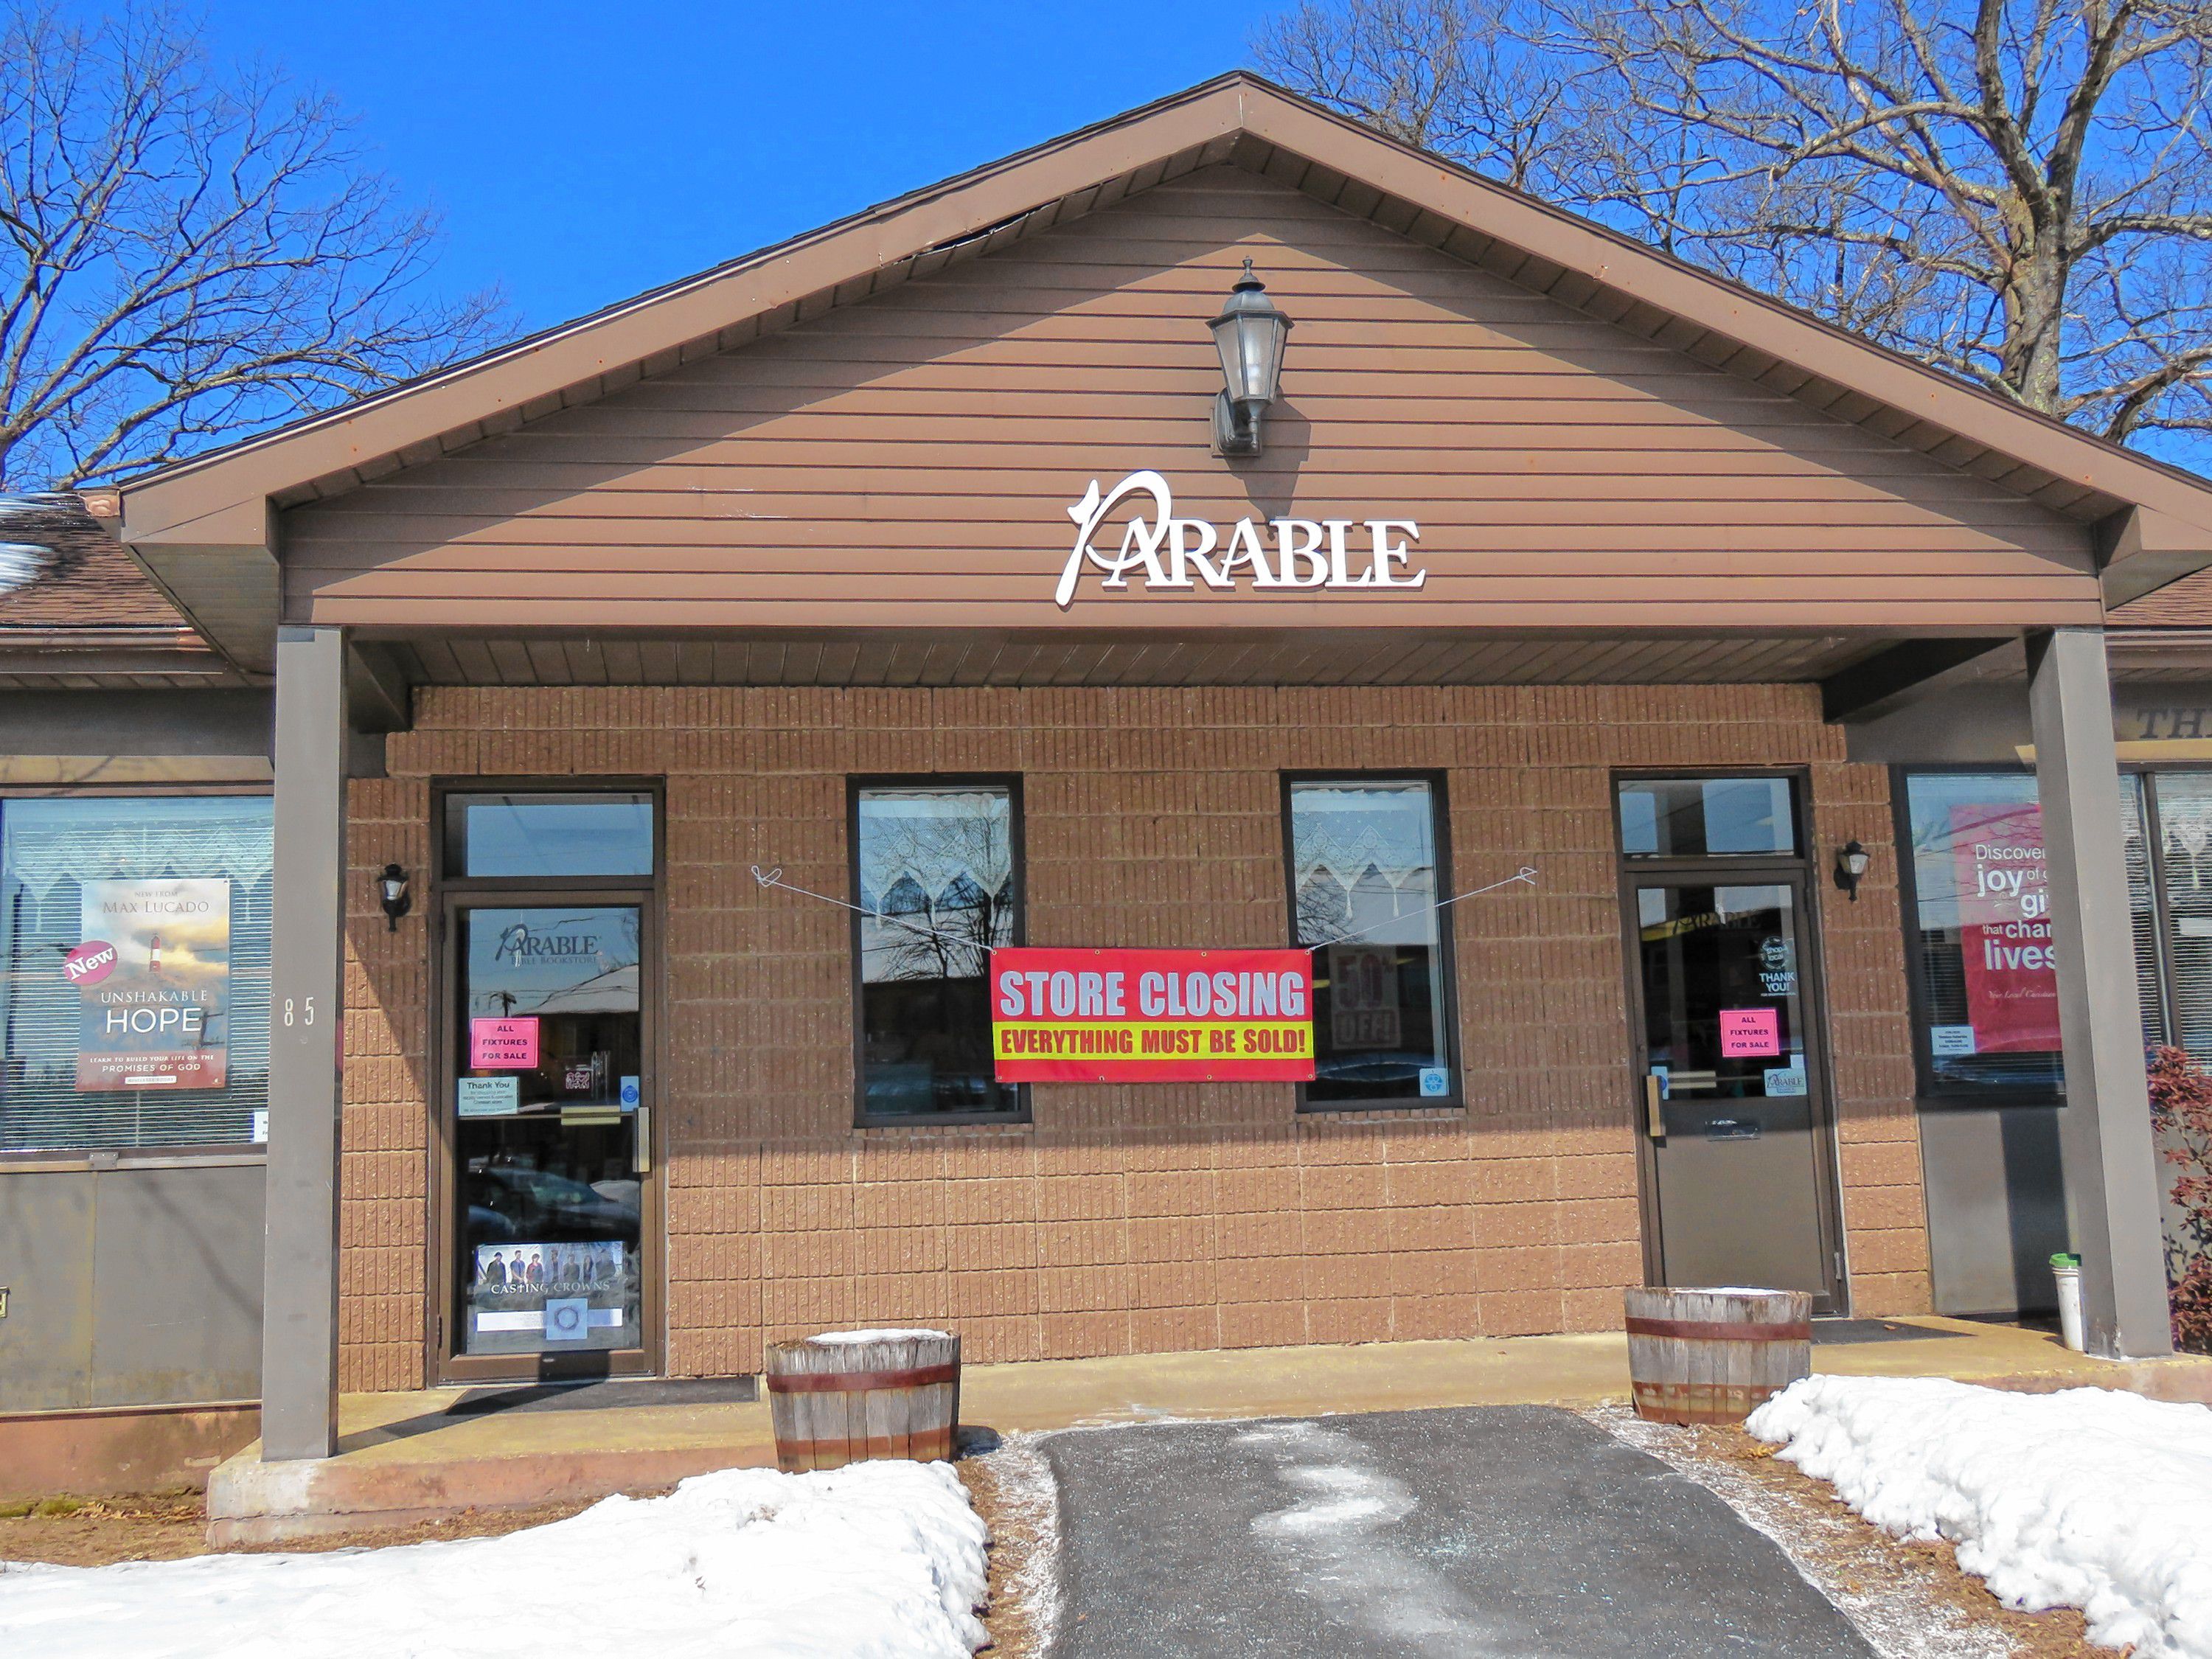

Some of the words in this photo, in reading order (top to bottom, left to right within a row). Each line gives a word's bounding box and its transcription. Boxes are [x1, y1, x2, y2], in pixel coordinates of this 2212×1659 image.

[1054, 469, 1427, 607] PARABLE
[2136, 706, 2212, 739] TH
[1977, 863, 2024, 897] joy
[2027, 867, 2040, 880] of
[103, 902, 138, 914] MAX
[145, 900, 210, 914] LUCADO
[2020, 888, 2049, 919] gi
[495, 923, 599, 961] PARABLE
[1982, 924, 2004, 935] that
[65, 947, 115, 981] New
[512, 957, 535, 965] BBLE
[1983, 939, 2056, 971] lives
[1759, 972, 1795, 983] THANK
[1766, 982, 1790, 992] YOU!
[100, 989, 208, 1004] UNSHAKABLE
[998, 970, 1126, 1018] STORE
[1138, 970, 1305, 1018] CLOSING
[105, 1007, 202, 1034] HOPE
[1001, 1029, 1133, 1054] EVERYTHING
[1141, 1029, 1203, 1054] MUST
[1209, 1029, 1237, 1054] BE
[1242, 1029, 1306, 1054] SOLD!
[102, 1064, 156, 1073] PROMISES
[178, 1063, 201, 1071] GOD
[467, 1082, 493, 1090] Thank
[490, 1283, 549, 1295] CASTING
[553, 1280, 611, 1292] CROWNS
